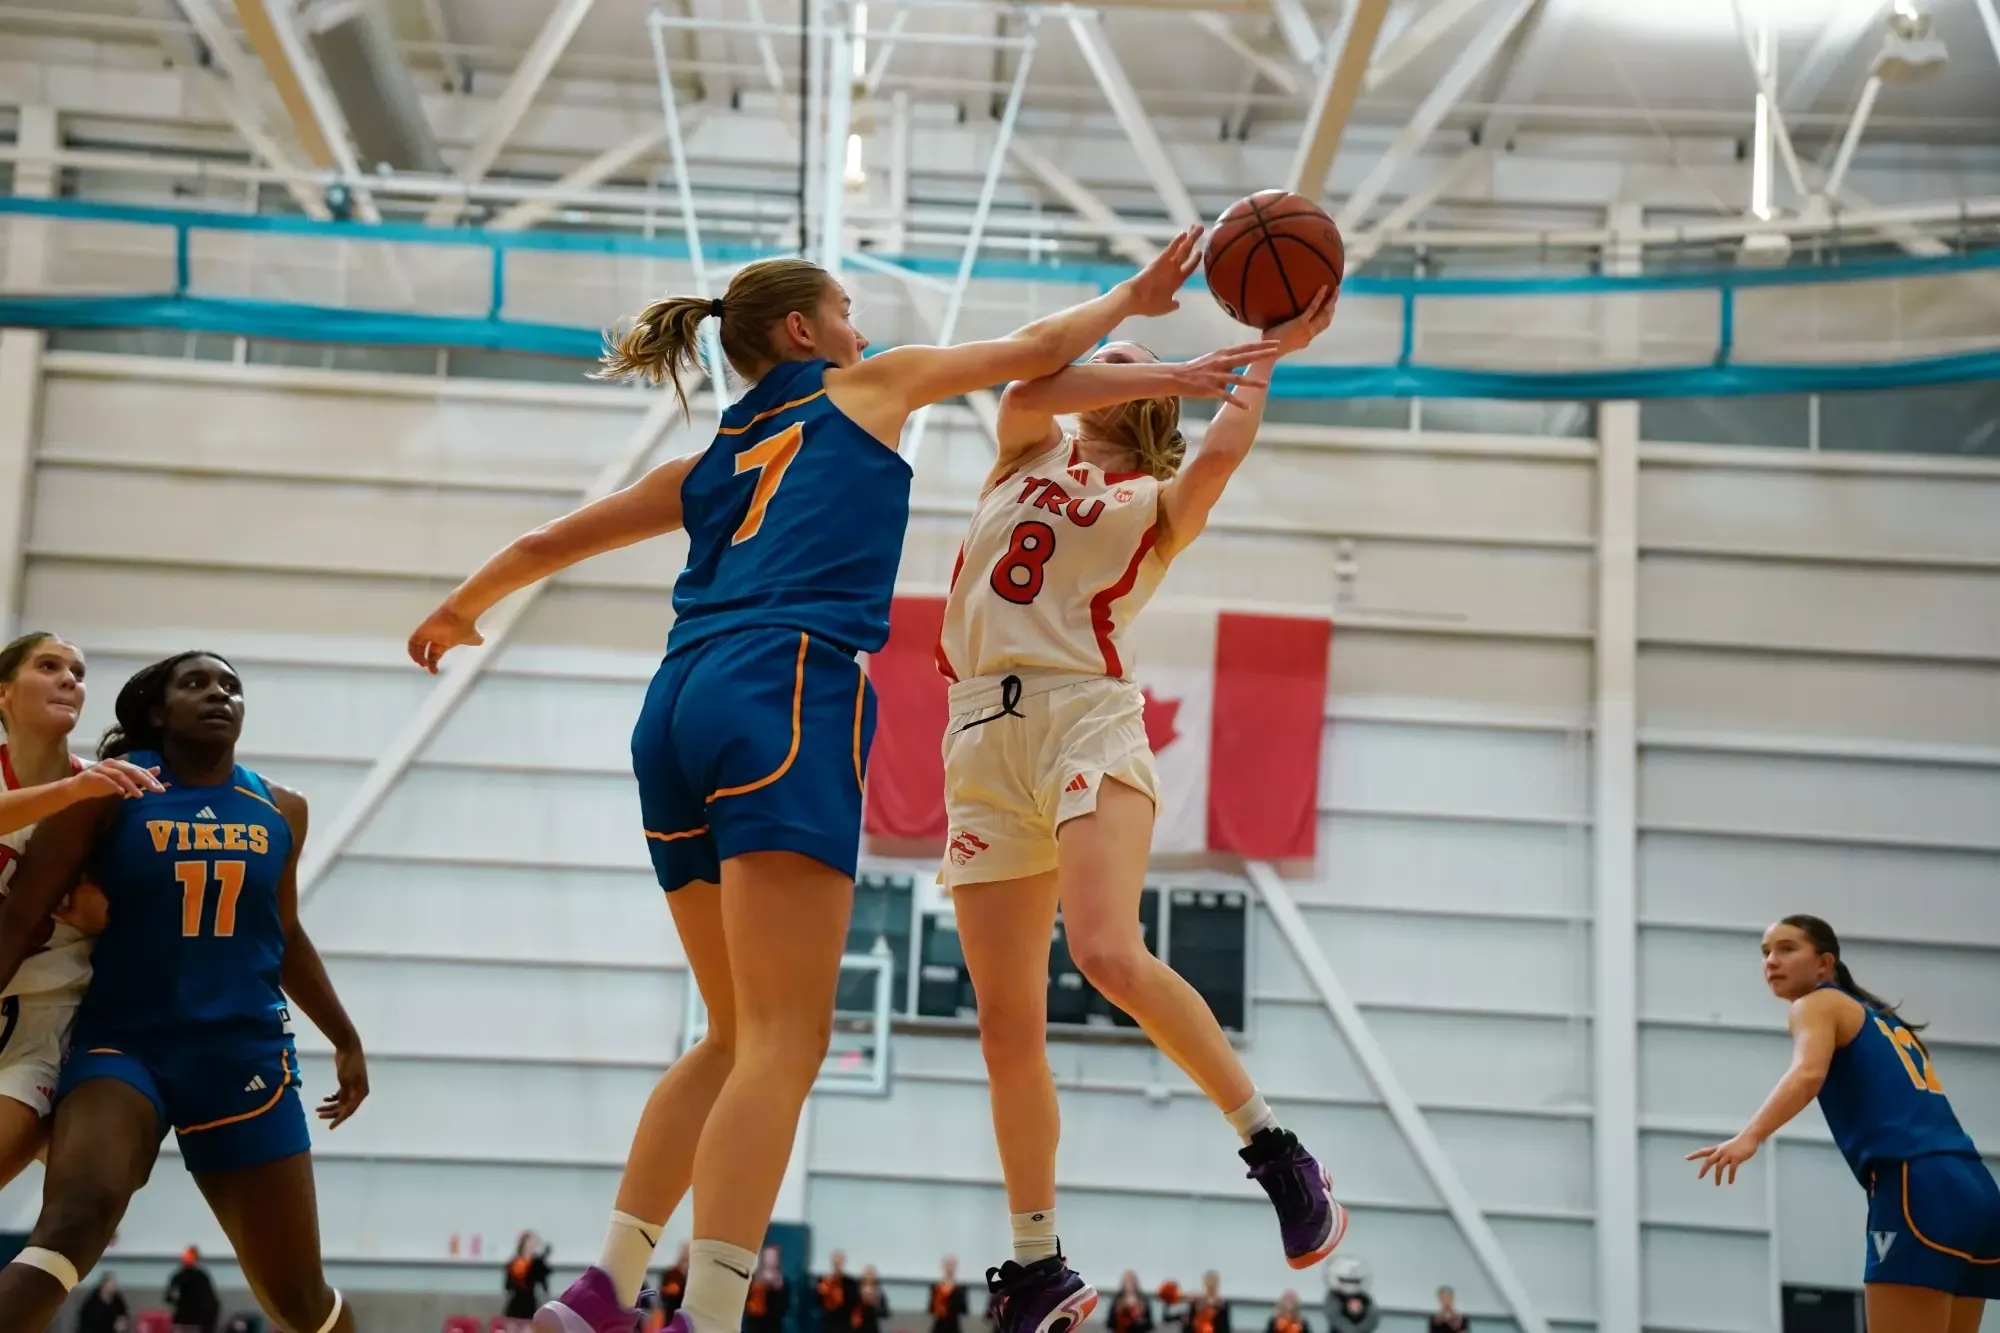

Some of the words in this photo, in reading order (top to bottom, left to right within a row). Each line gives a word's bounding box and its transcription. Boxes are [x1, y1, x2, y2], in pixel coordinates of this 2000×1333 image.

[731, 421, 805, 547] 7
[1016, 476, 1105, 527] TRU
[990, 520, 1055, 605] 8
[146, 820, 269, 854] VIKES
[174, 860, 246, 937] 11
[1870, 1230, 1898, 1263] V
